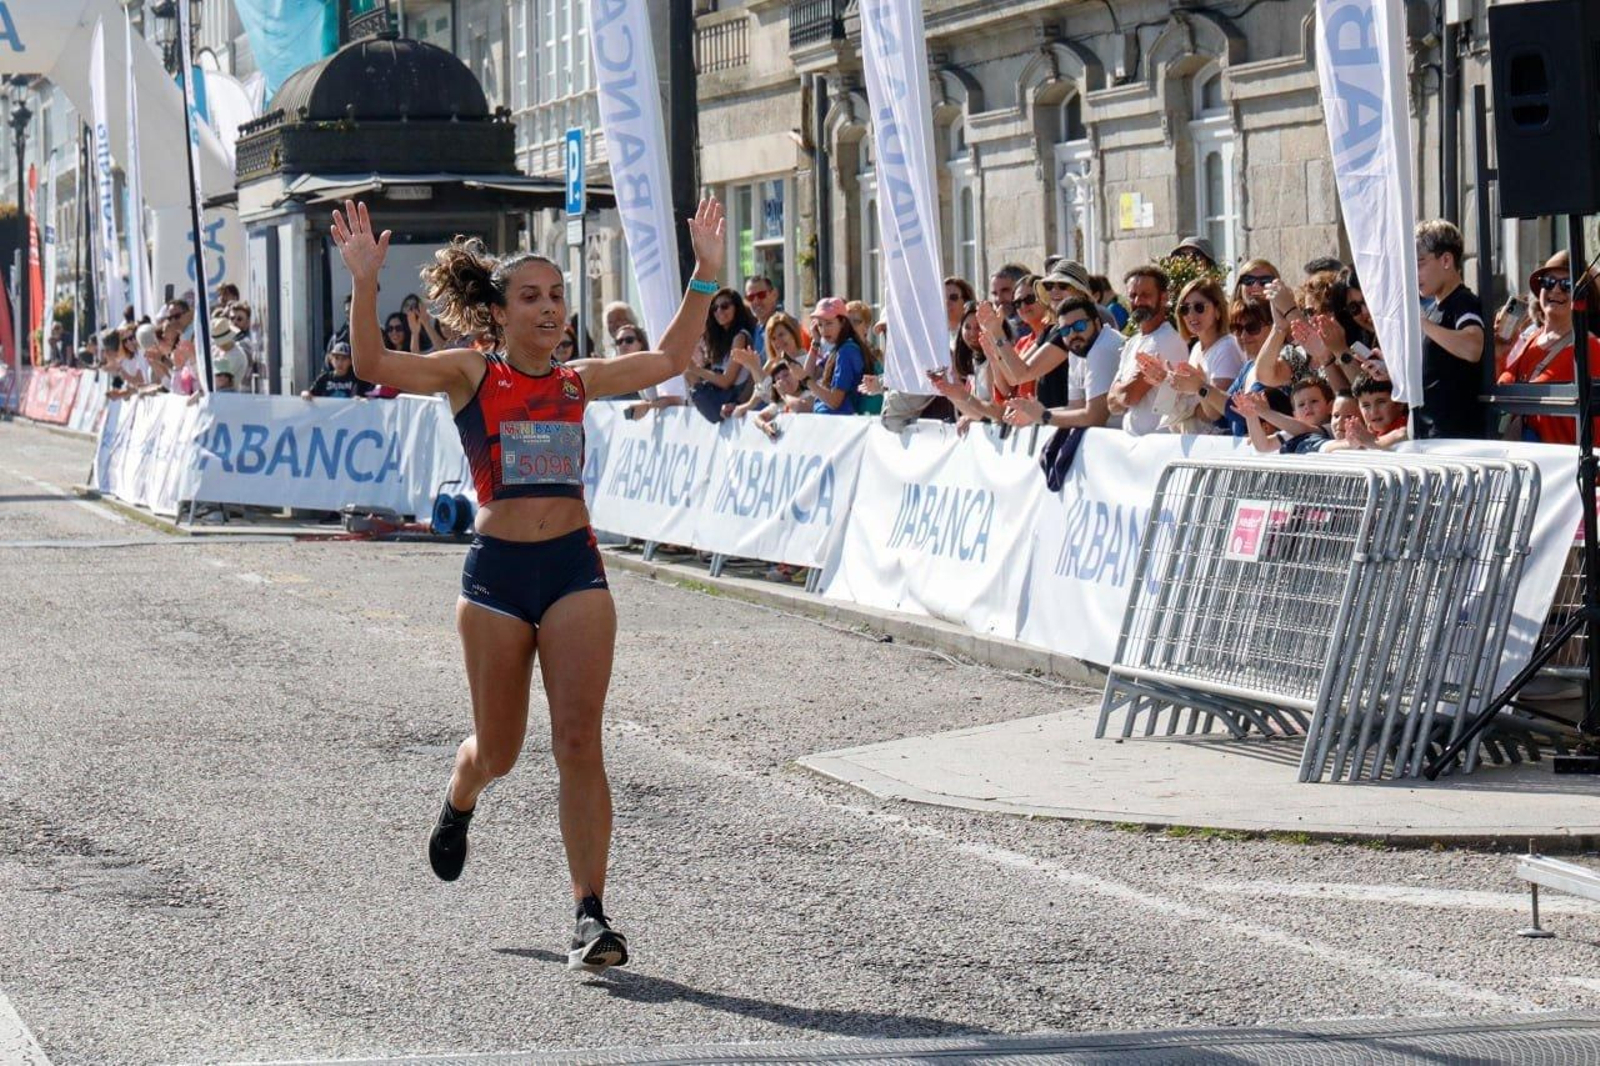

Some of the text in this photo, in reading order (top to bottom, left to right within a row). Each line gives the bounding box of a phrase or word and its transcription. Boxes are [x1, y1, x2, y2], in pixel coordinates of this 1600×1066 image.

[568, 139, 579, 205] P
[613, 438, 699, 508] ABANCA
[720, 450, 836, 526] ABANCA
[895, 483, 995, 563] ABANCA
[1064, 499, 1191, 595] ABANC
